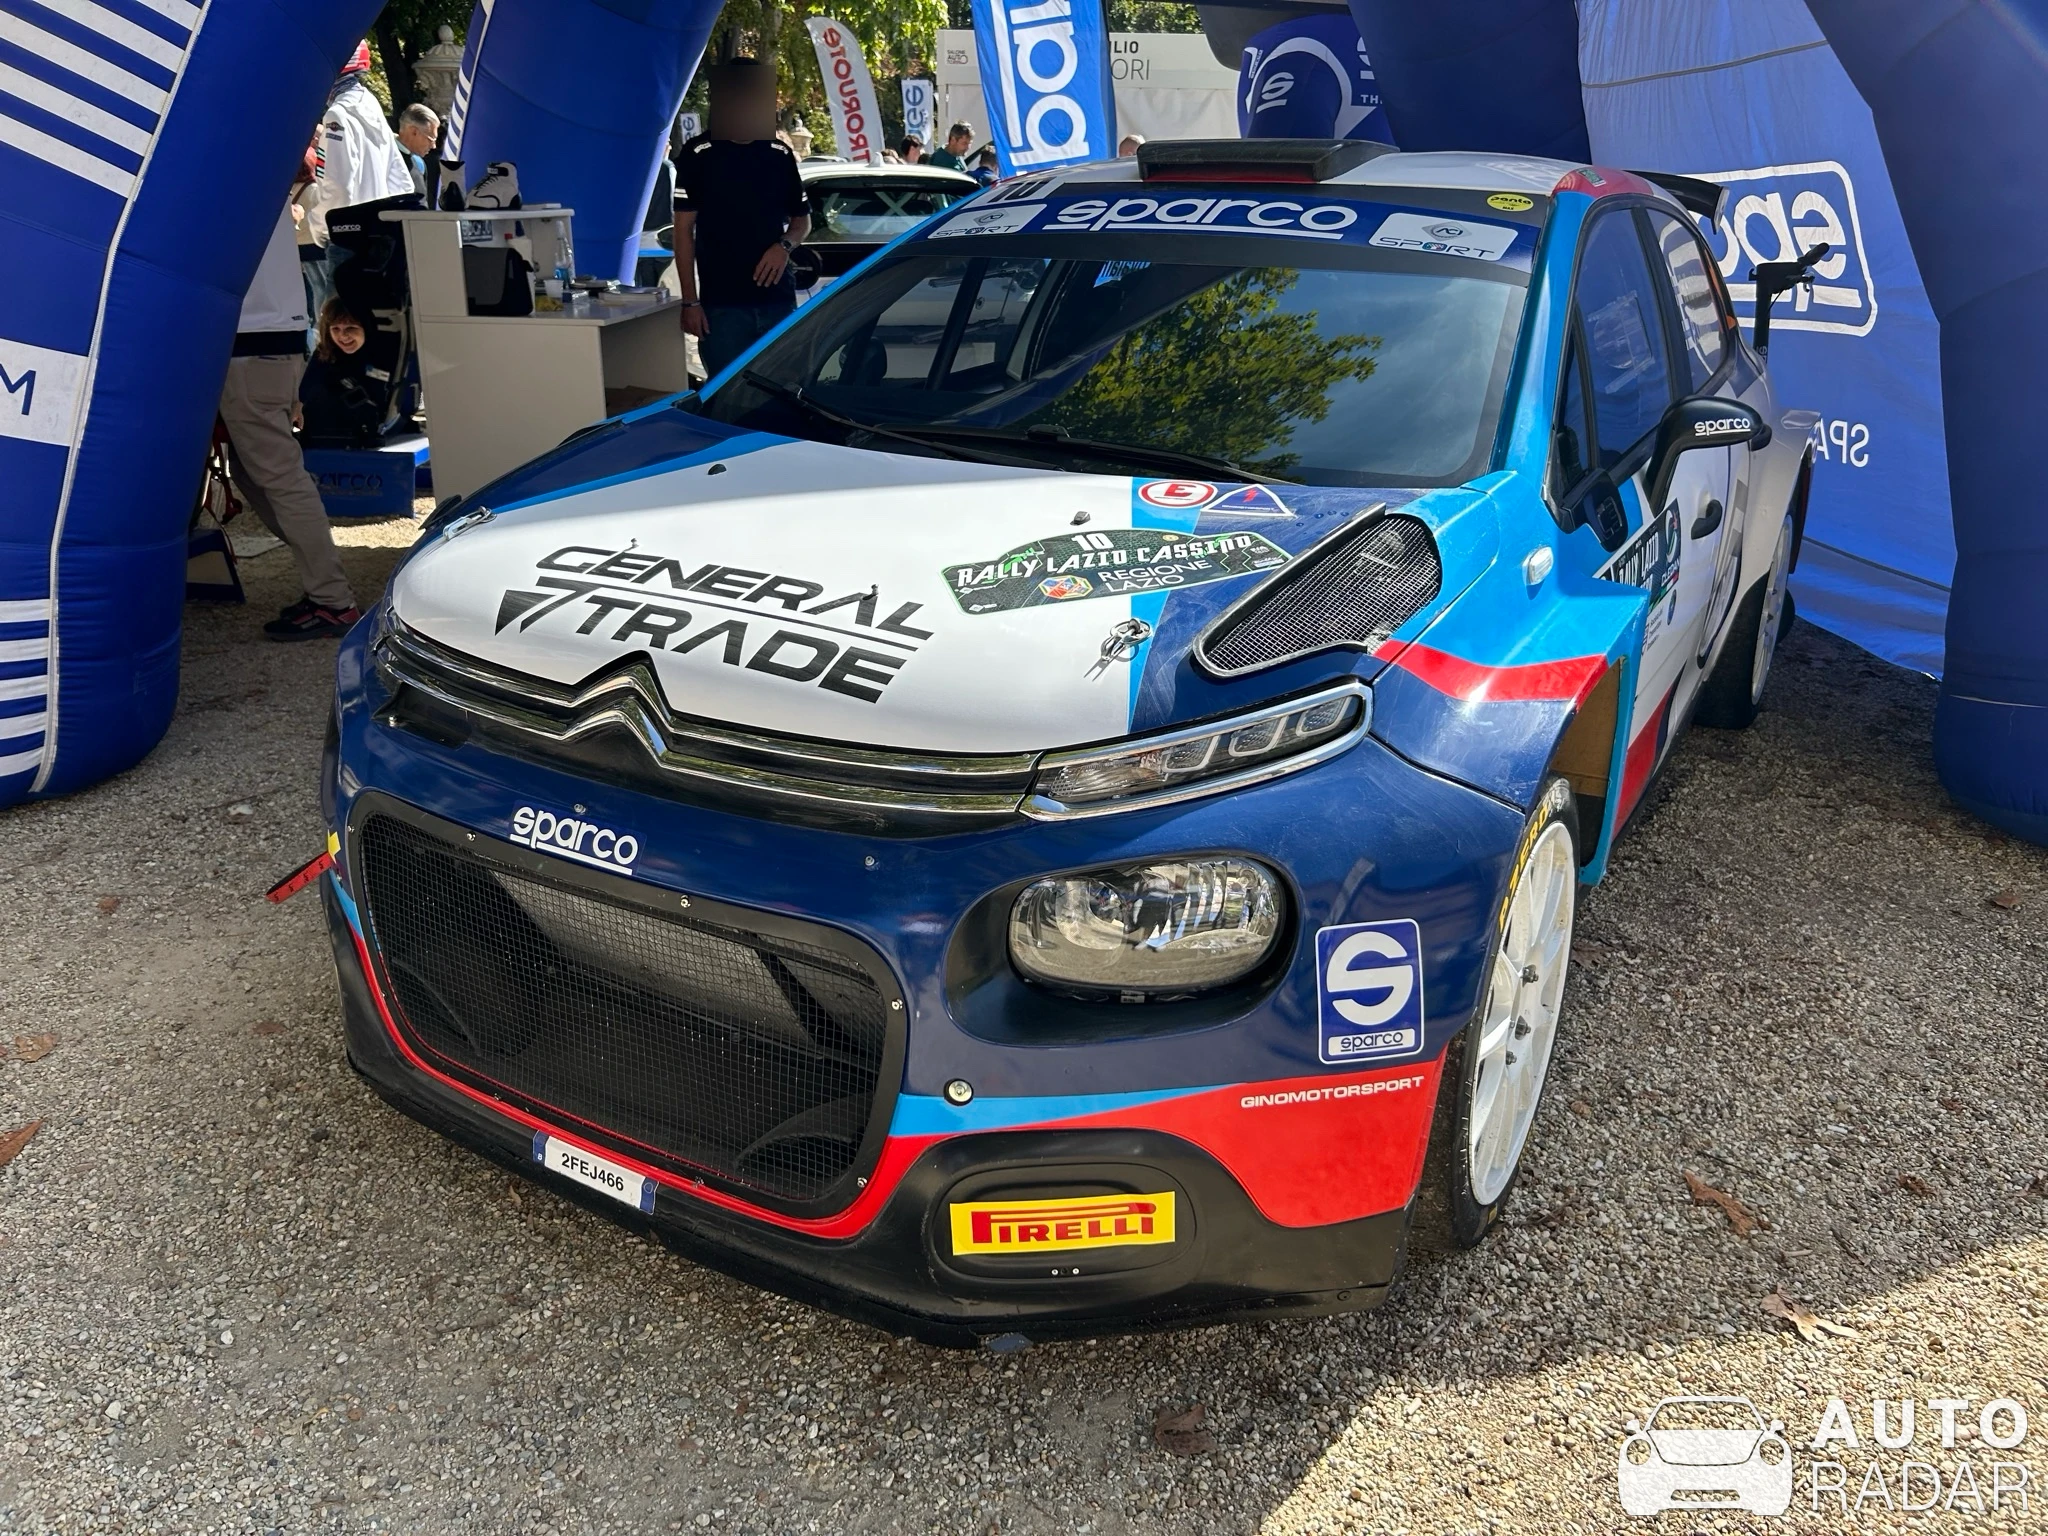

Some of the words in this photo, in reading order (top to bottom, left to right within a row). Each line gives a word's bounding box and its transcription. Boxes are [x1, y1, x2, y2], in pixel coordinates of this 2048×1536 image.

[1111, 58, 1150, 81] ORI
[1360, 95, 1383, 104] TH
[1056, 198, 1358, 232] sparco
[935, 224, 1019, 238] SPORT
[1379, 236, 1495, 258] SPORT
[1694, 416, 1751, 437] sparco
[1071, 532, 1115, 551] 10
[957, 559, 1038, 587] RALLY
[1047, 550, 1127, 573] LAZIO
[1137, 535, 1252, 563] CASSINO
[1097, 560, 1213, 581] REGIONE
[535, 546, 935, 641] GENERAL
[1105, 574, 1185, 593] LAZIO
[575, 593, 908, 704] TRADE
[512, 806, 639, 866] sparco
[1340, 1031, 1404, 1052] sparco
[1240, 1076, 1425, 1109] GINOMOTORSPORT
[561, 1152, 624, 1192] 2FEJ466
[971, 1202, 1157, 1244] PIRELLI
